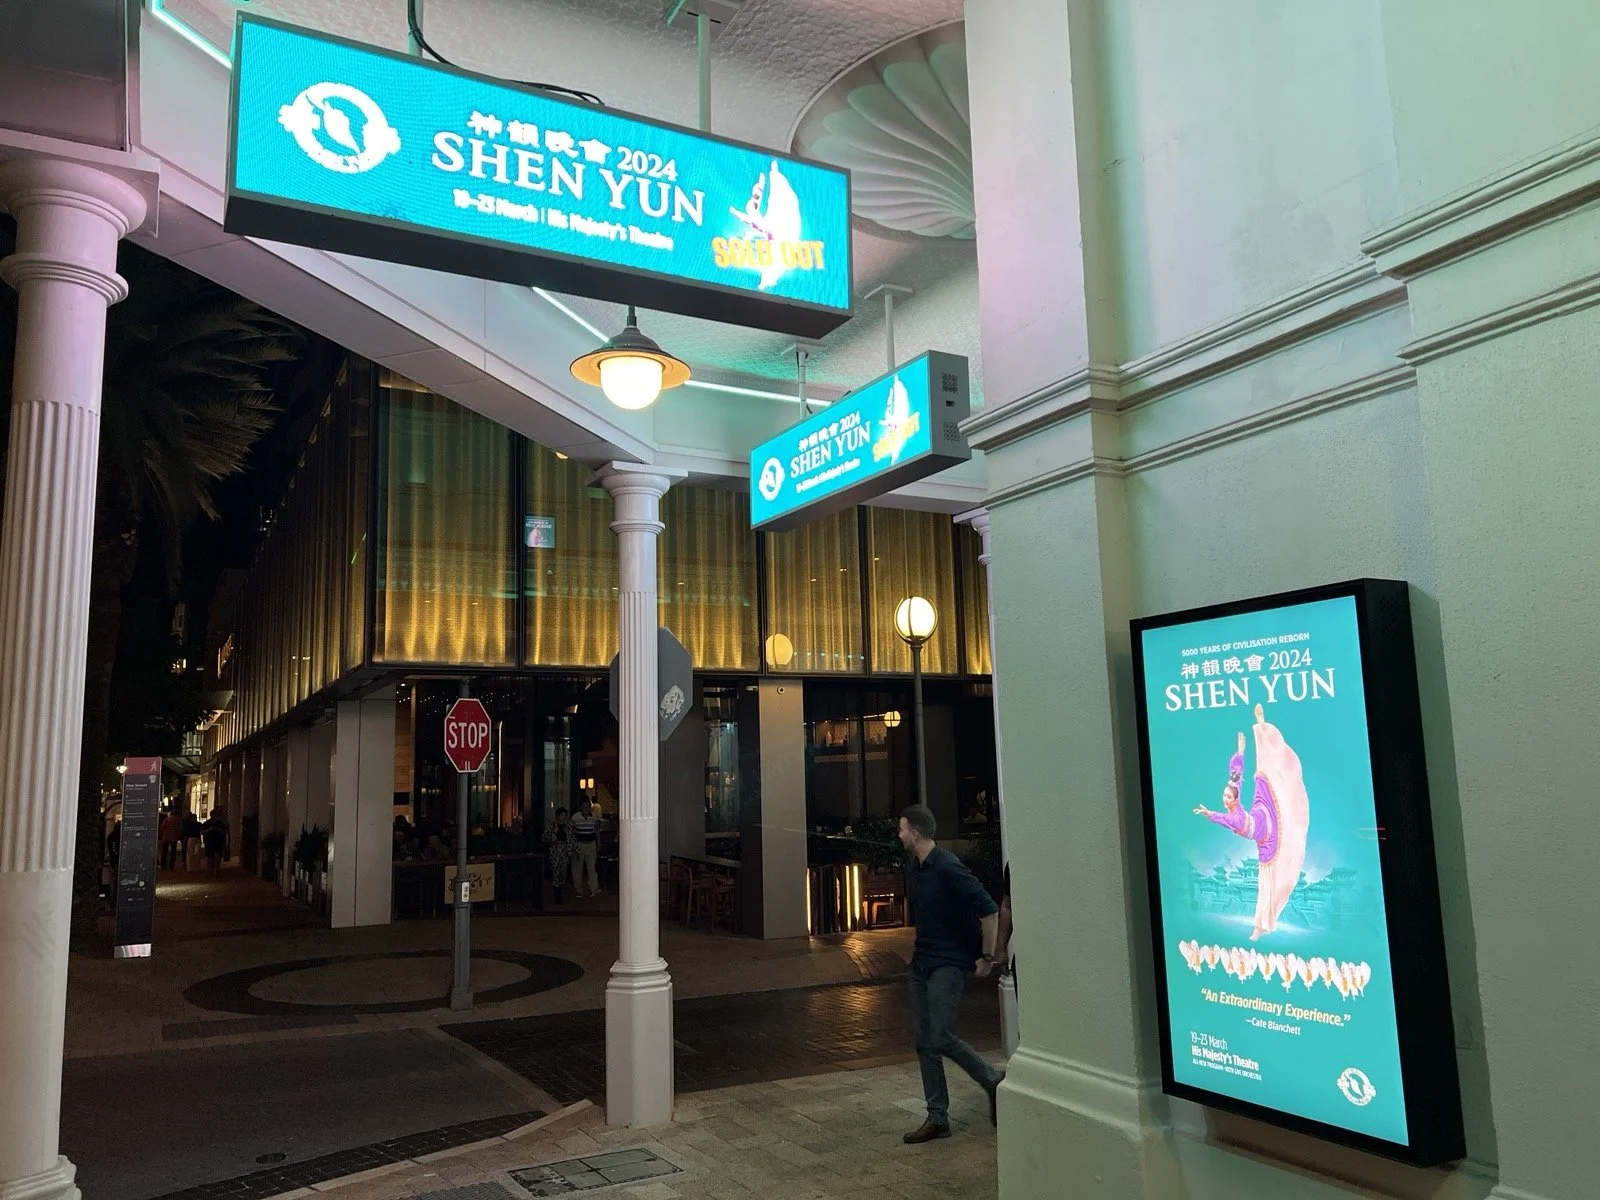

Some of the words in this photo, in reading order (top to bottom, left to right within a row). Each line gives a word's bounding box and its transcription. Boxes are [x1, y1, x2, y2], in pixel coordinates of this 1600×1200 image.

[431, 131, 584, 201] SHEN
[598, 168, 707, 227] YUN
[617, 145, 679, 181] 2024
[712, 236, 773, 268] SOLD
[781, 240, 825, 270] OUT
[790, 441, 832, 478] SHEN
[835, 420, 870, 456] YUN
[1181, 647, 1199, 657] 5000
[1199, 644, 1221, 656] YEARS
[1221, 642, 1232, 652] OF
[1233, 636, 1278, 651] CIVILISATION
[1279, 632, 1310, 644] REBORN
[1180, 654, 1265, 680] 神韻晚會
[1269, 648, 1312, 671] 2024
[1165, 676, 1251, 712] SHEN
[1259, 668, 1336, 704] YUN
[448, 722, 488, 749] STOP
[1220, 991, 1283, 1016] Extraordinary
[1285, 1004, 1351, 1028] Experience.”
[1208, 1035, 1228, 1050] March
[1267, 1019, 1302, 1036] Blanchett
[1191, 1045, 1202, 1057] His
[1232, 1055, 1260, 1071] Theatre
